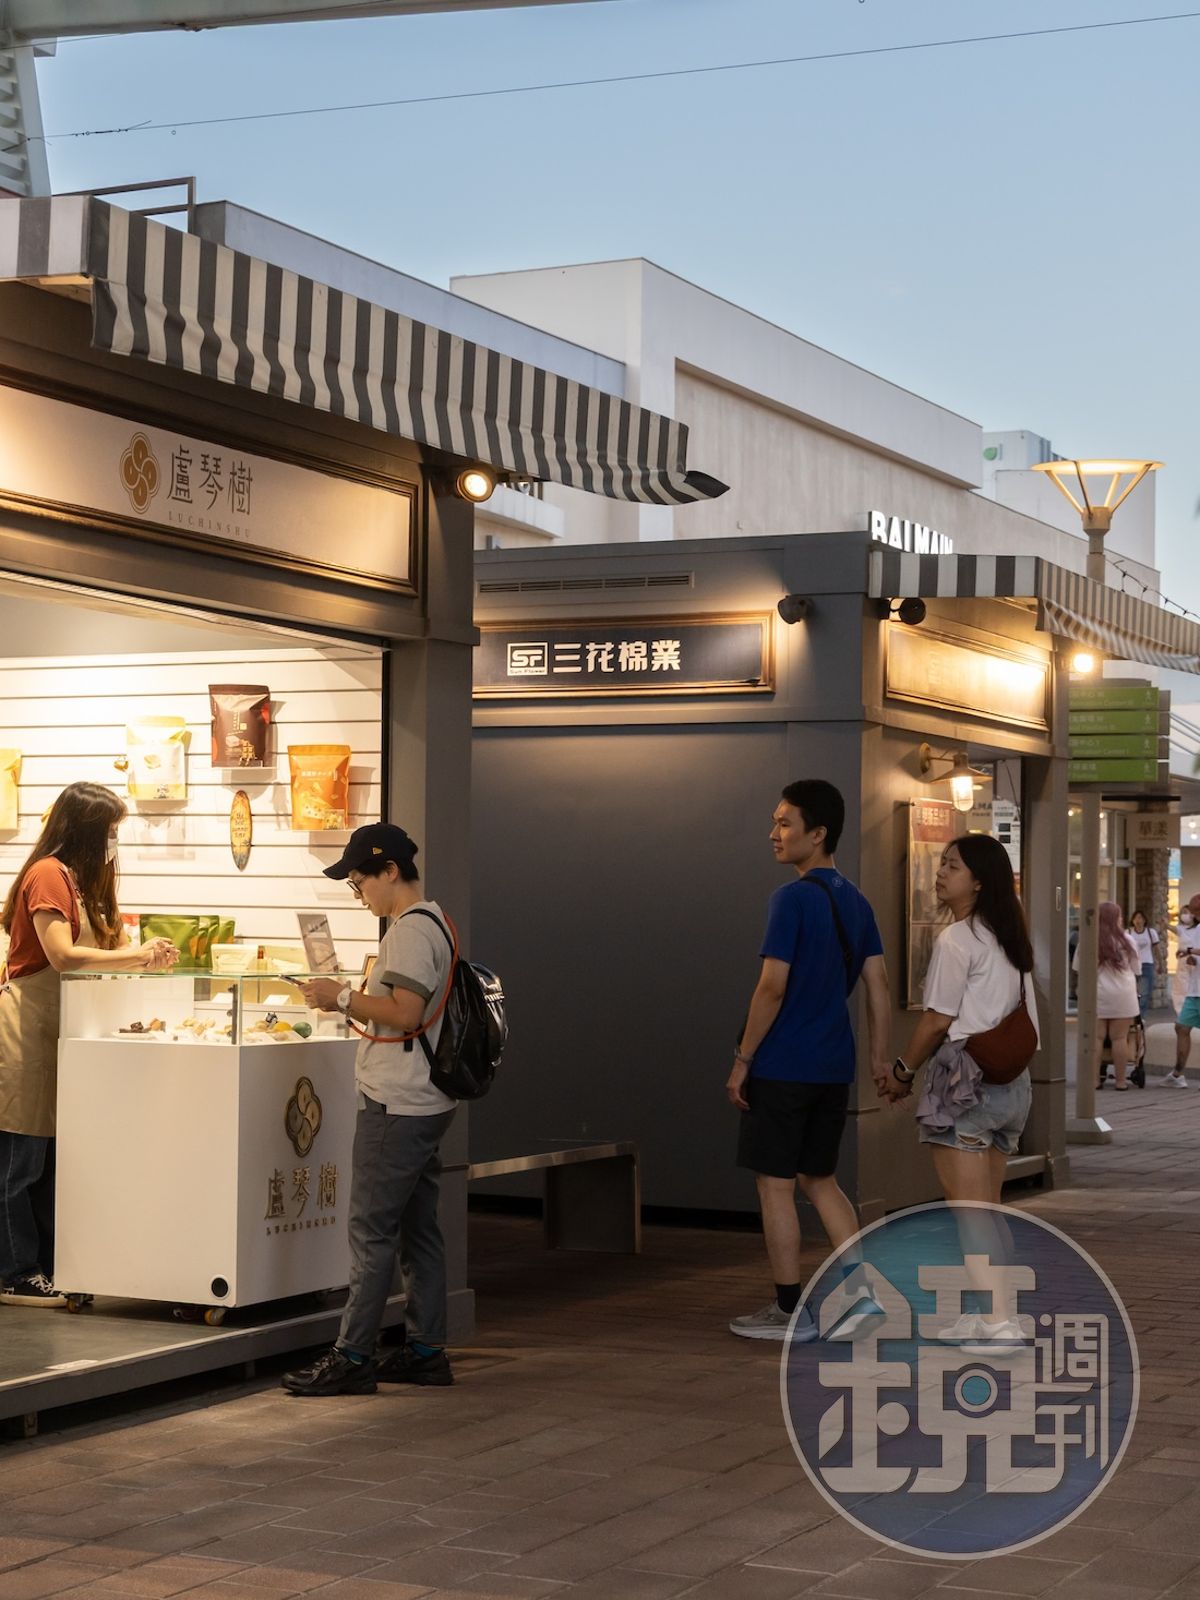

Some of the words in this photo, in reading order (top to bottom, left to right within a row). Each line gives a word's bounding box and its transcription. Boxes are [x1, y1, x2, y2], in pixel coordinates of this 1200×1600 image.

[166, 443, 253, 516] 盧琴樹
[168, 510, 250, 538] LUCHINSHU
[552, 639, 681, 673] 三花棉業
